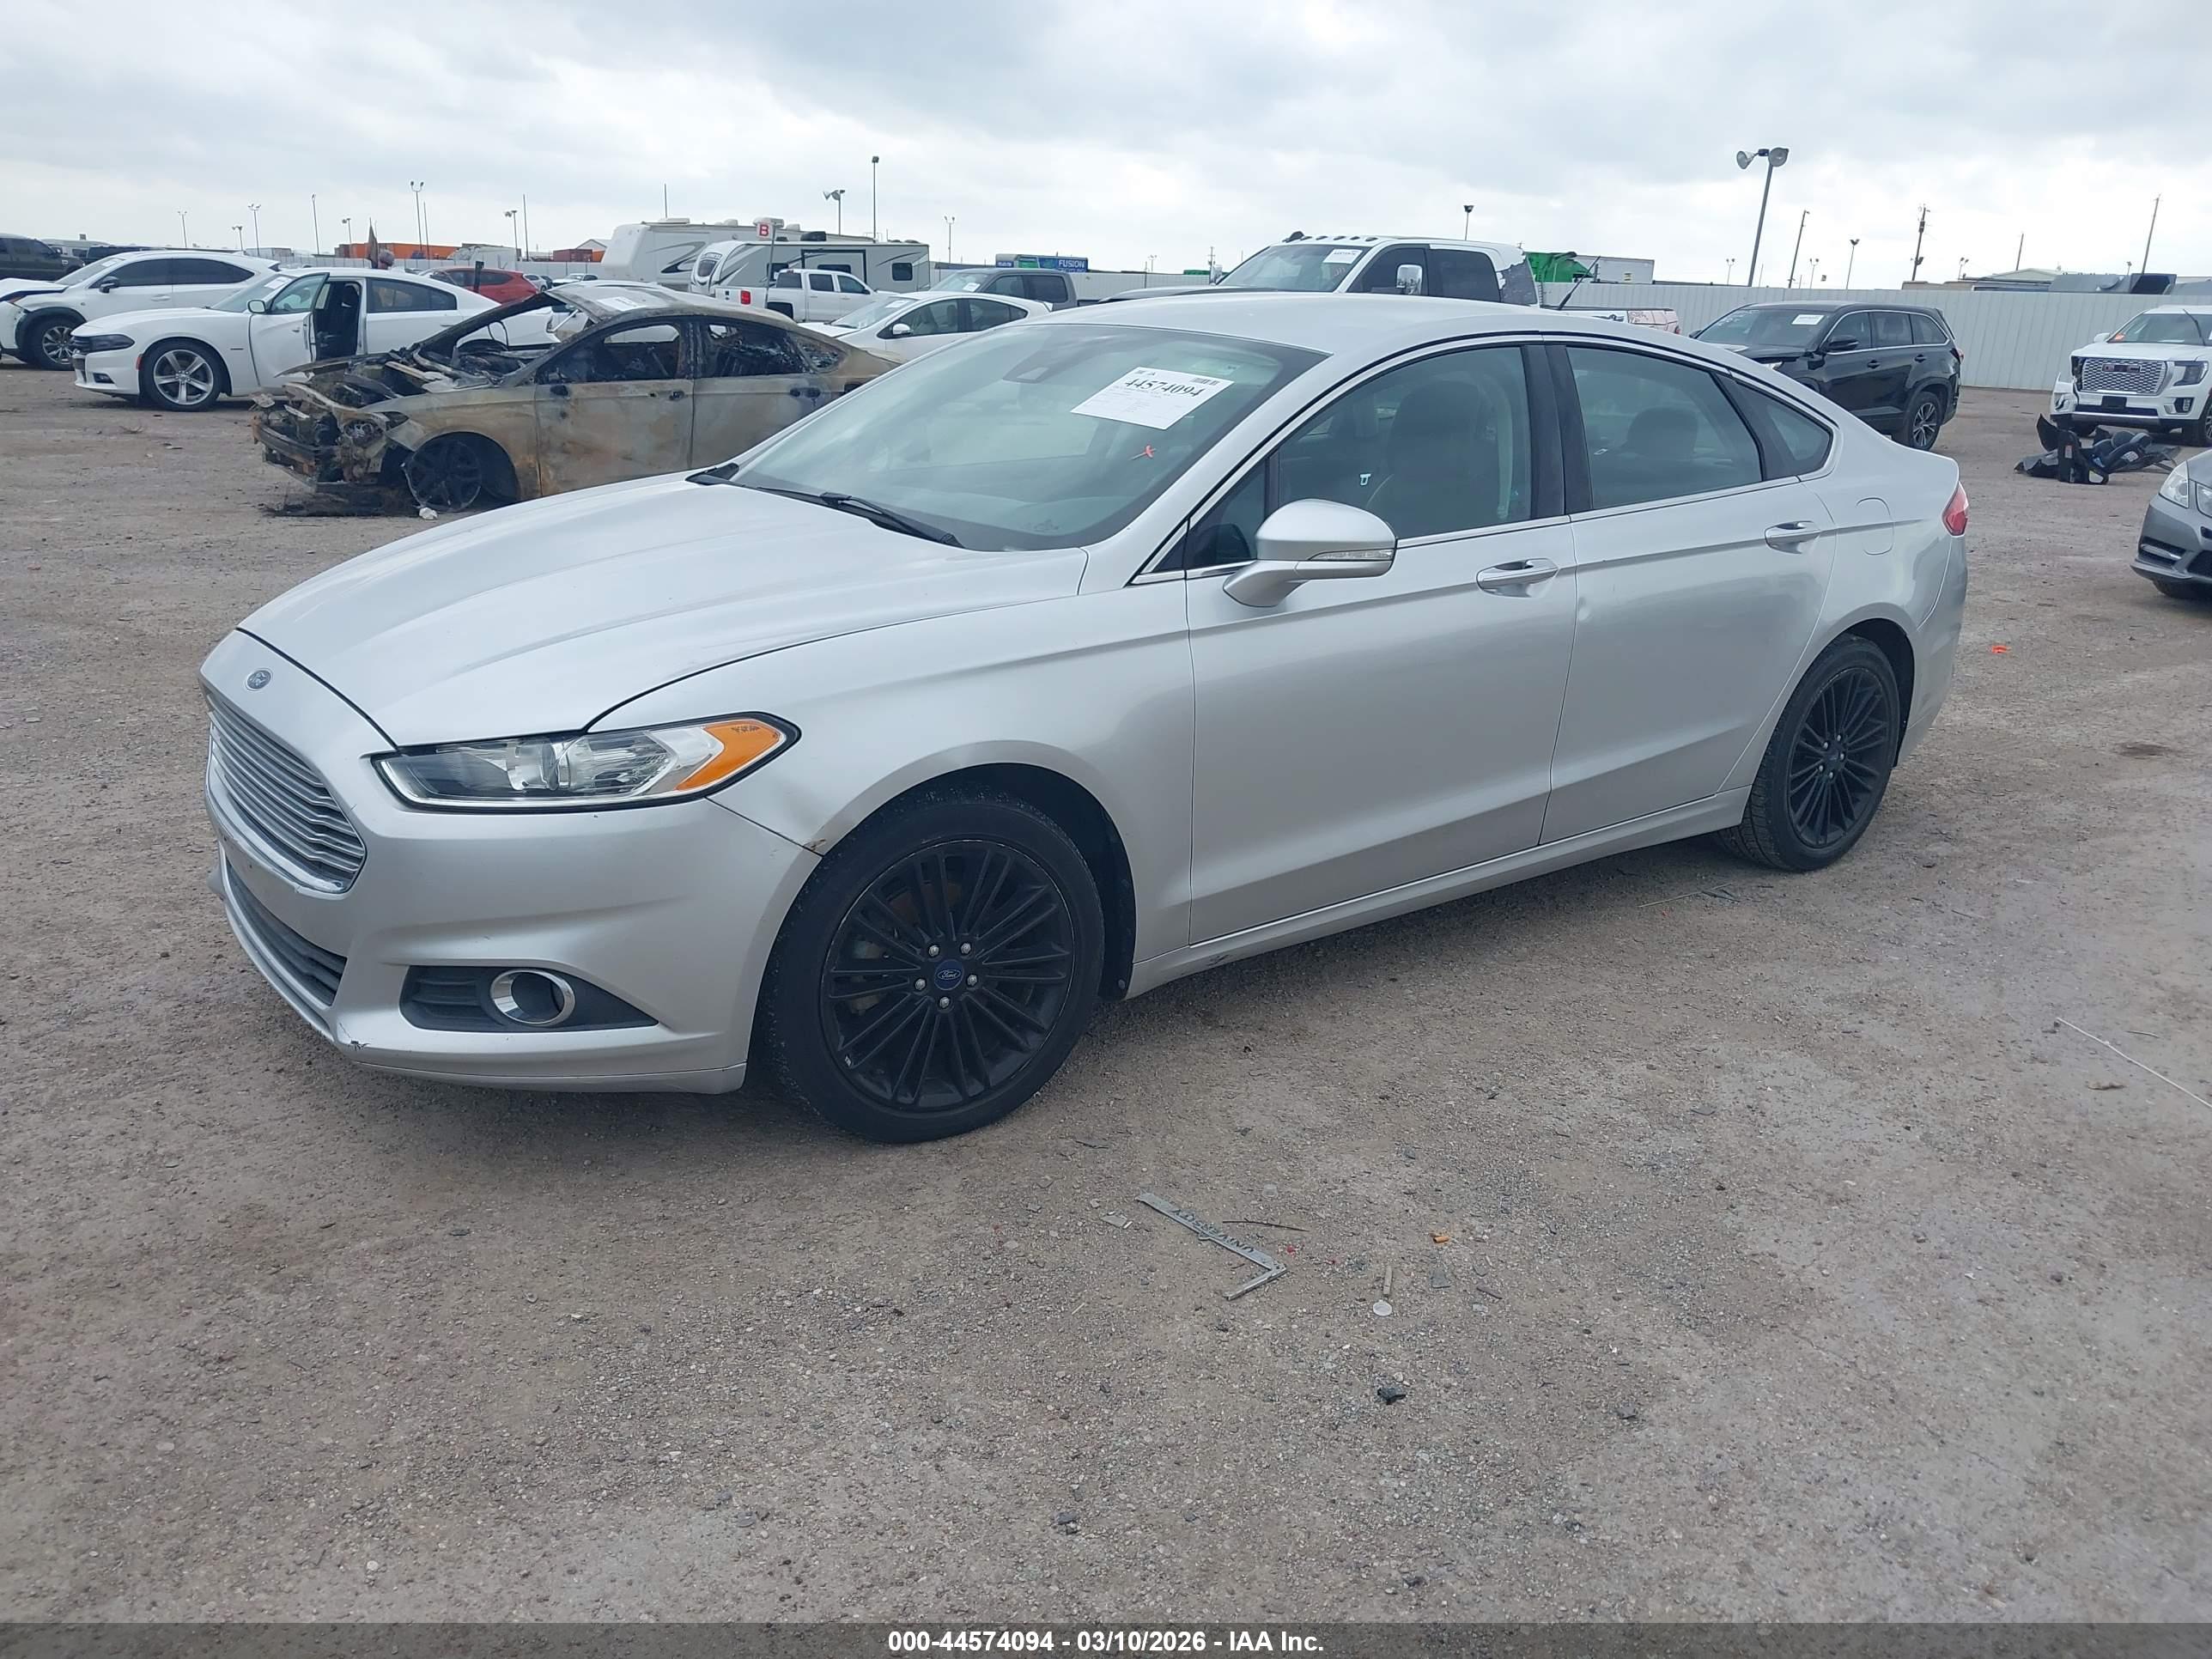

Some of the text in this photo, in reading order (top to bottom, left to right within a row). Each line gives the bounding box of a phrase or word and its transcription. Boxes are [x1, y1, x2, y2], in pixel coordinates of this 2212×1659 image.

[759, 224, 769, 237] B
[1058, 259, 1085, 268] FUSION
[1125, 379, 1205, 397] 44574094
